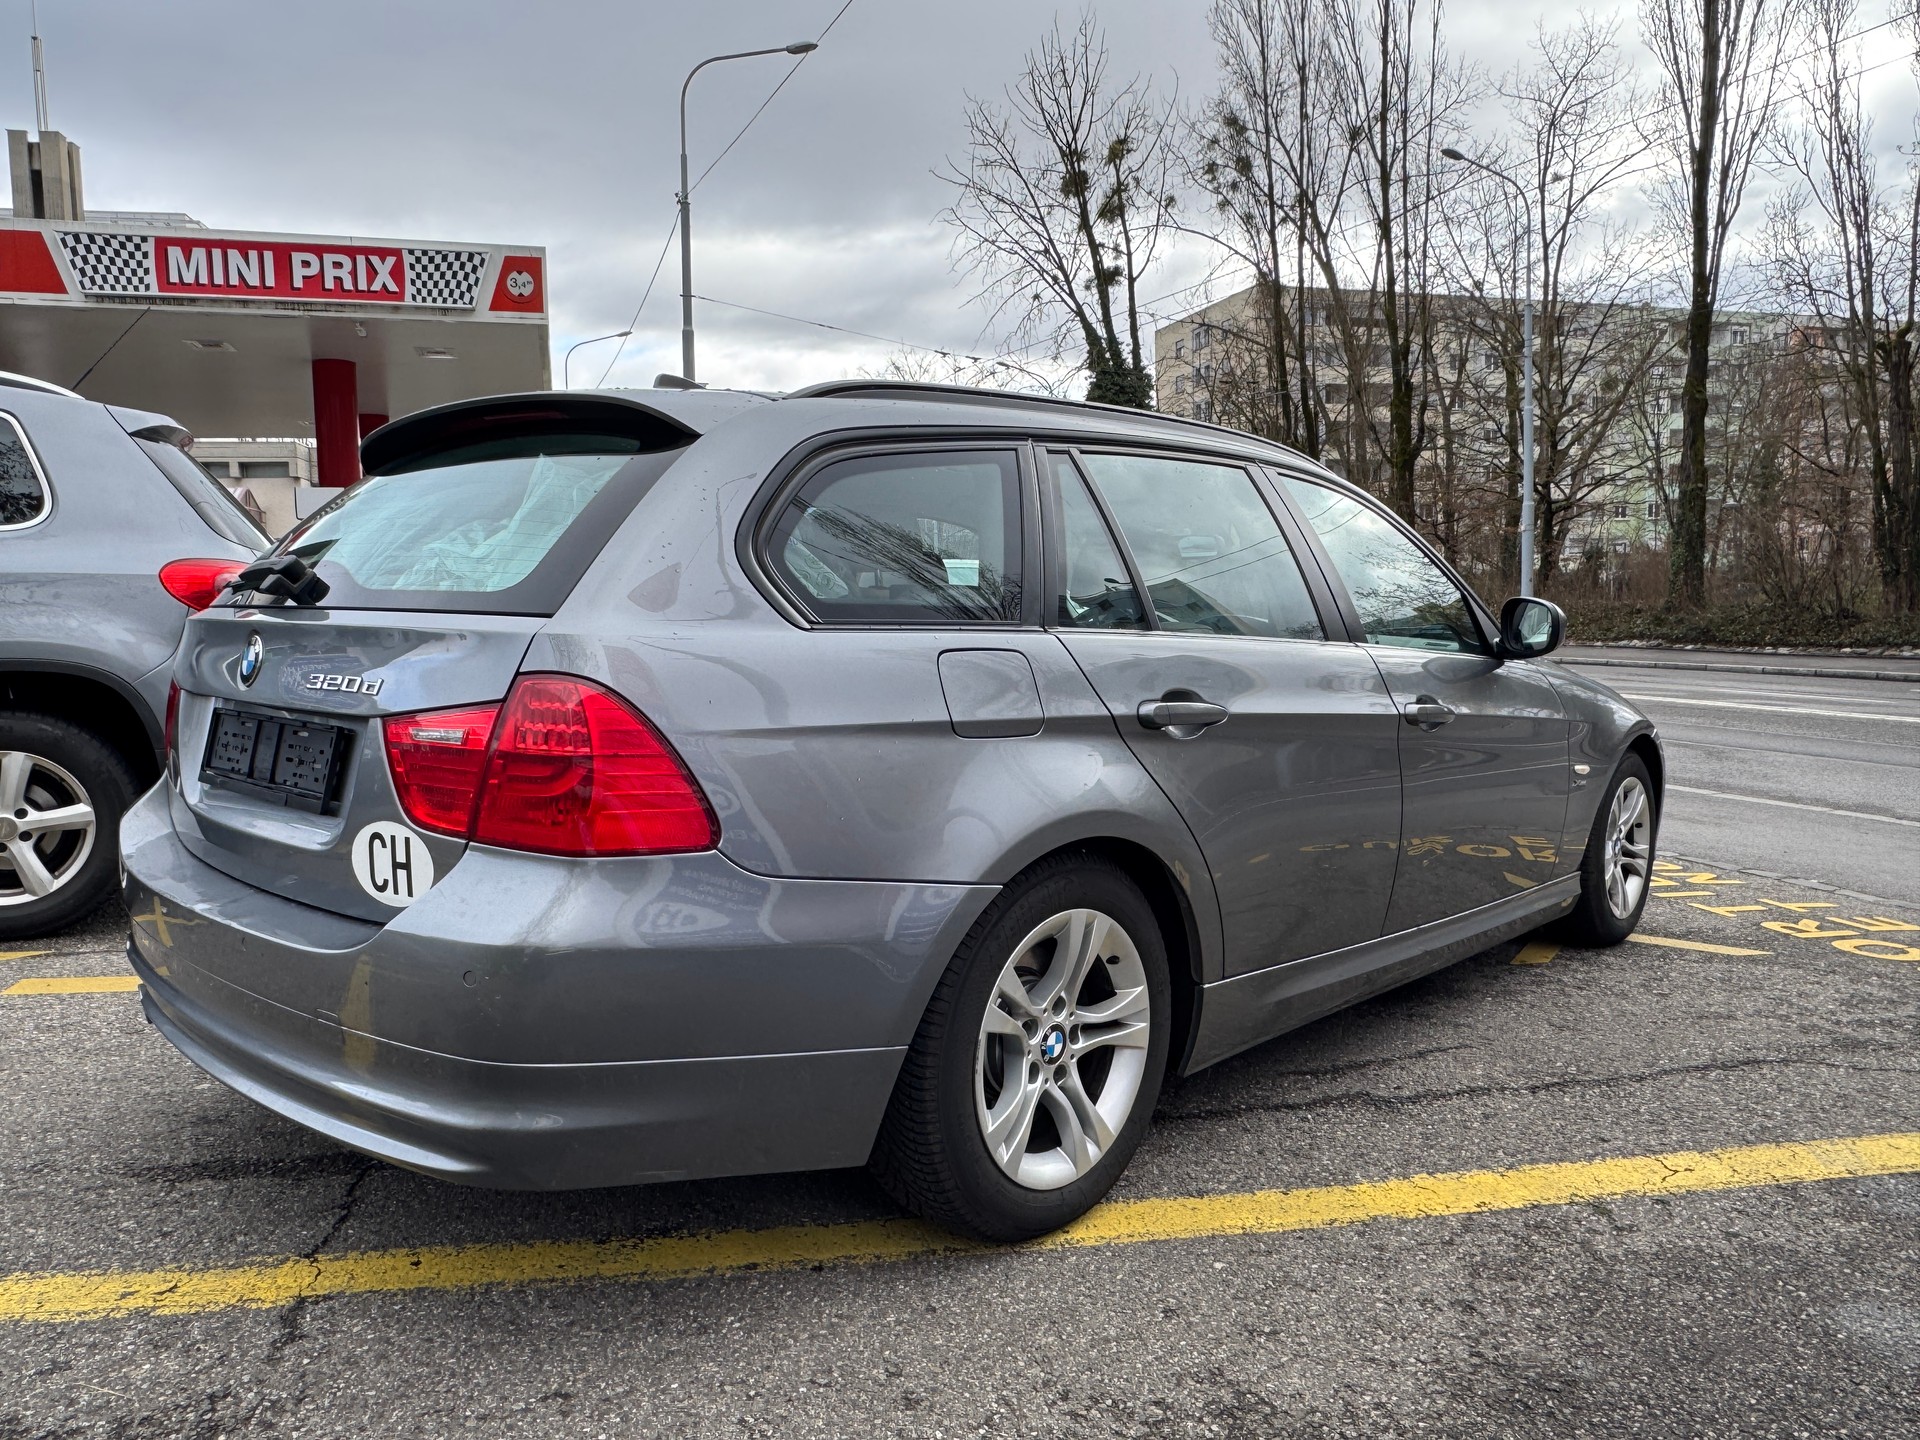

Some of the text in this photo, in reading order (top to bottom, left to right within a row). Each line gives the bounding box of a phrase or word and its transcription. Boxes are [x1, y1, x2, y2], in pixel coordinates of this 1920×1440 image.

[166, 245, 399, 293] MINI PRIX
[306, 673, 384, 696] 320d
[368, 831, 414, 898] CH
[1649, 875, 1920, 962] ORTI
